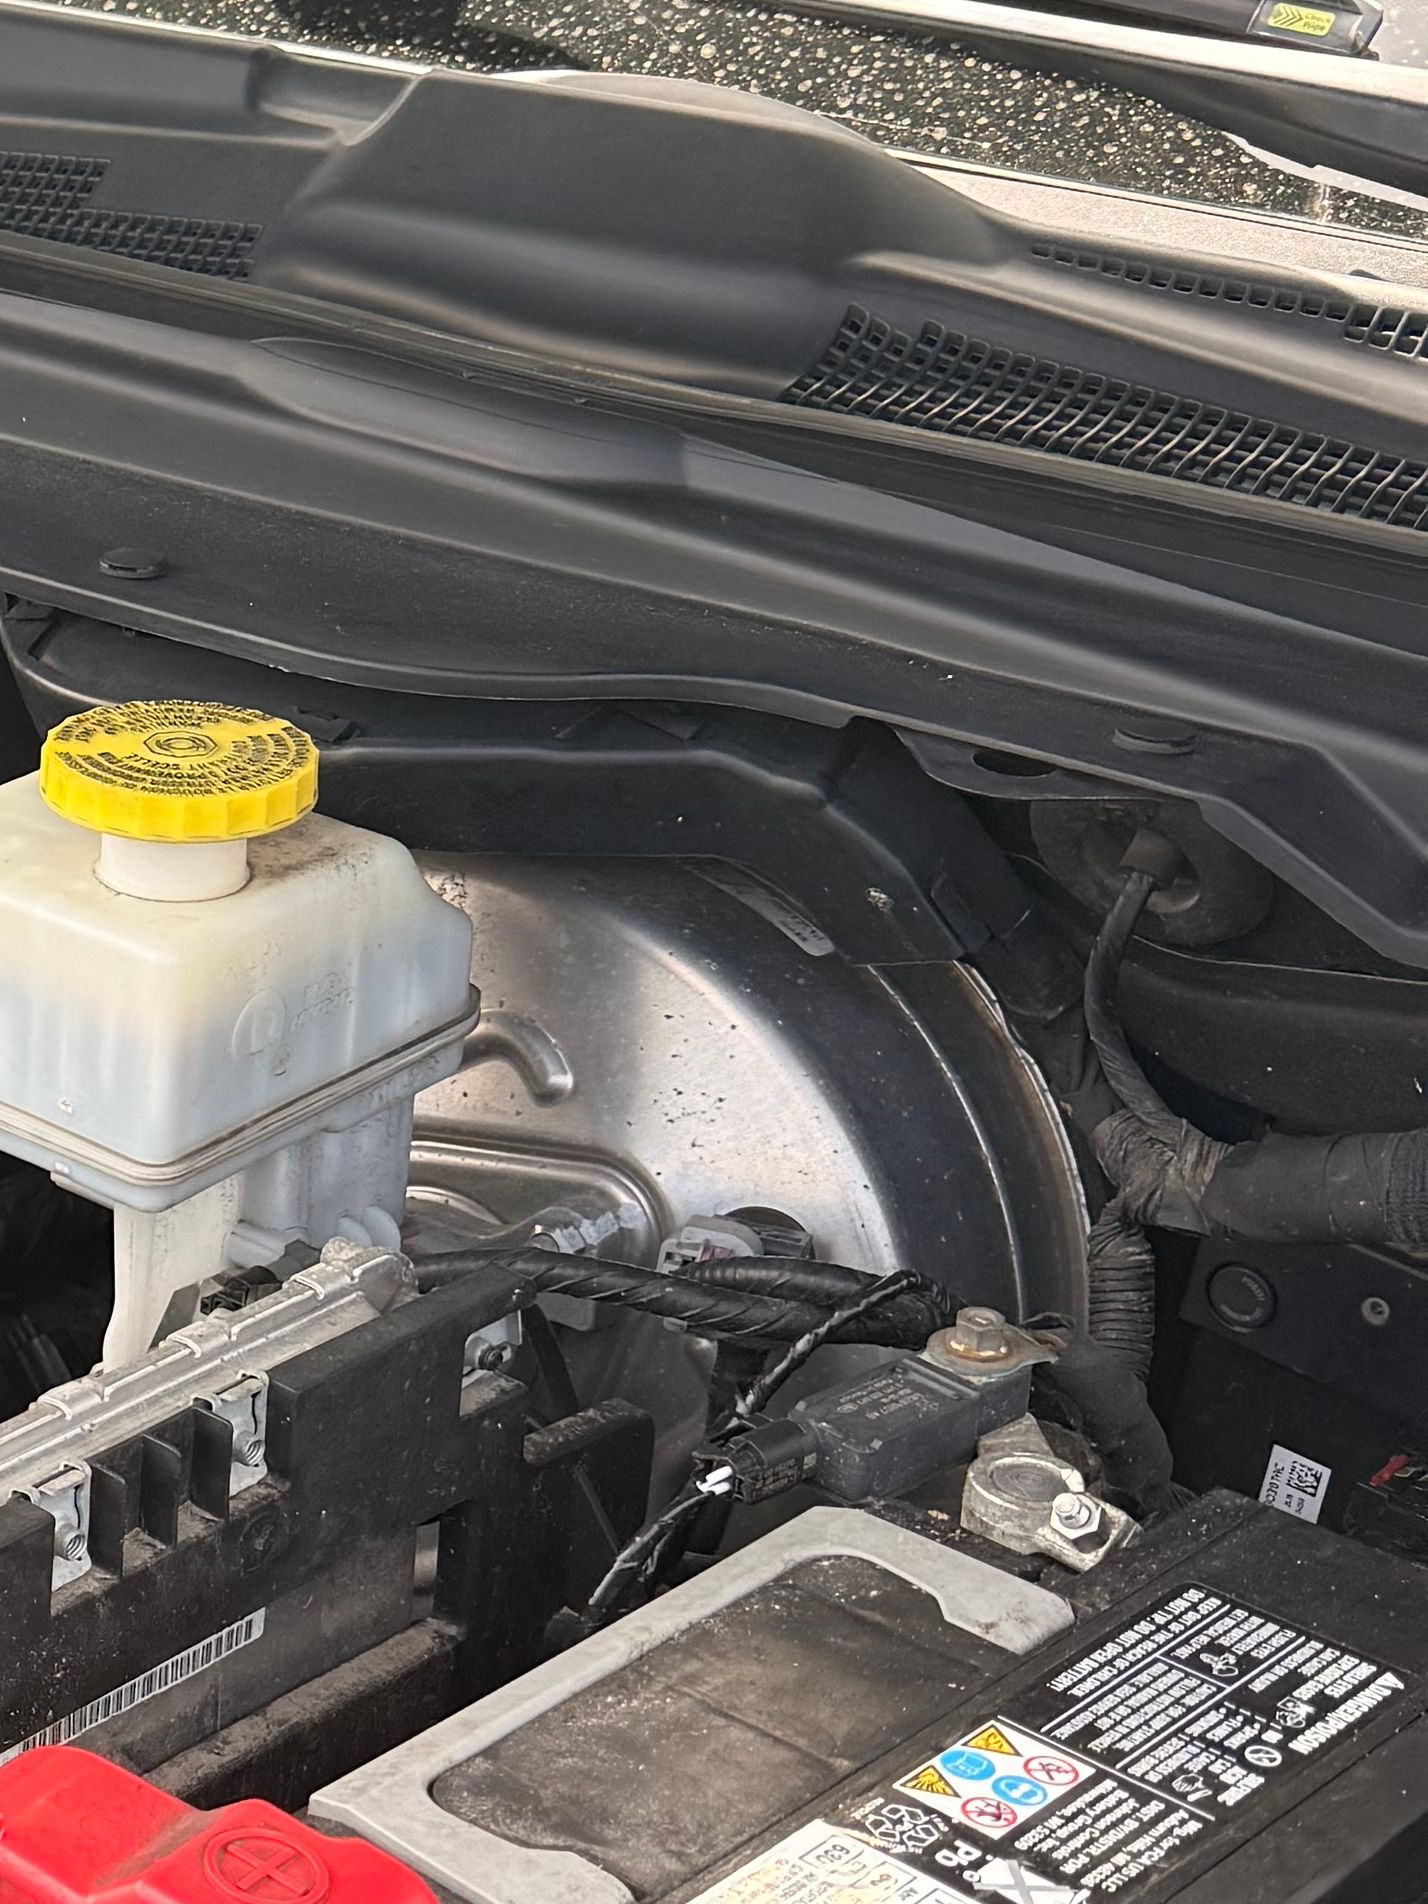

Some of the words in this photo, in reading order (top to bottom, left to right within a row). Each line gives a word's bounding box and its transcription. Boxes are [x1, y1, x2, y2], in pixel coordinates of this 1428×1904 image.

[1287, 1681, 1392, 1755] DANGER/POISON
[1092, 1796, 1140, 1830] Johnson
[933, 1838, 983, 1867] Pb
[1050, 1826, 1100, 1860] Controls
